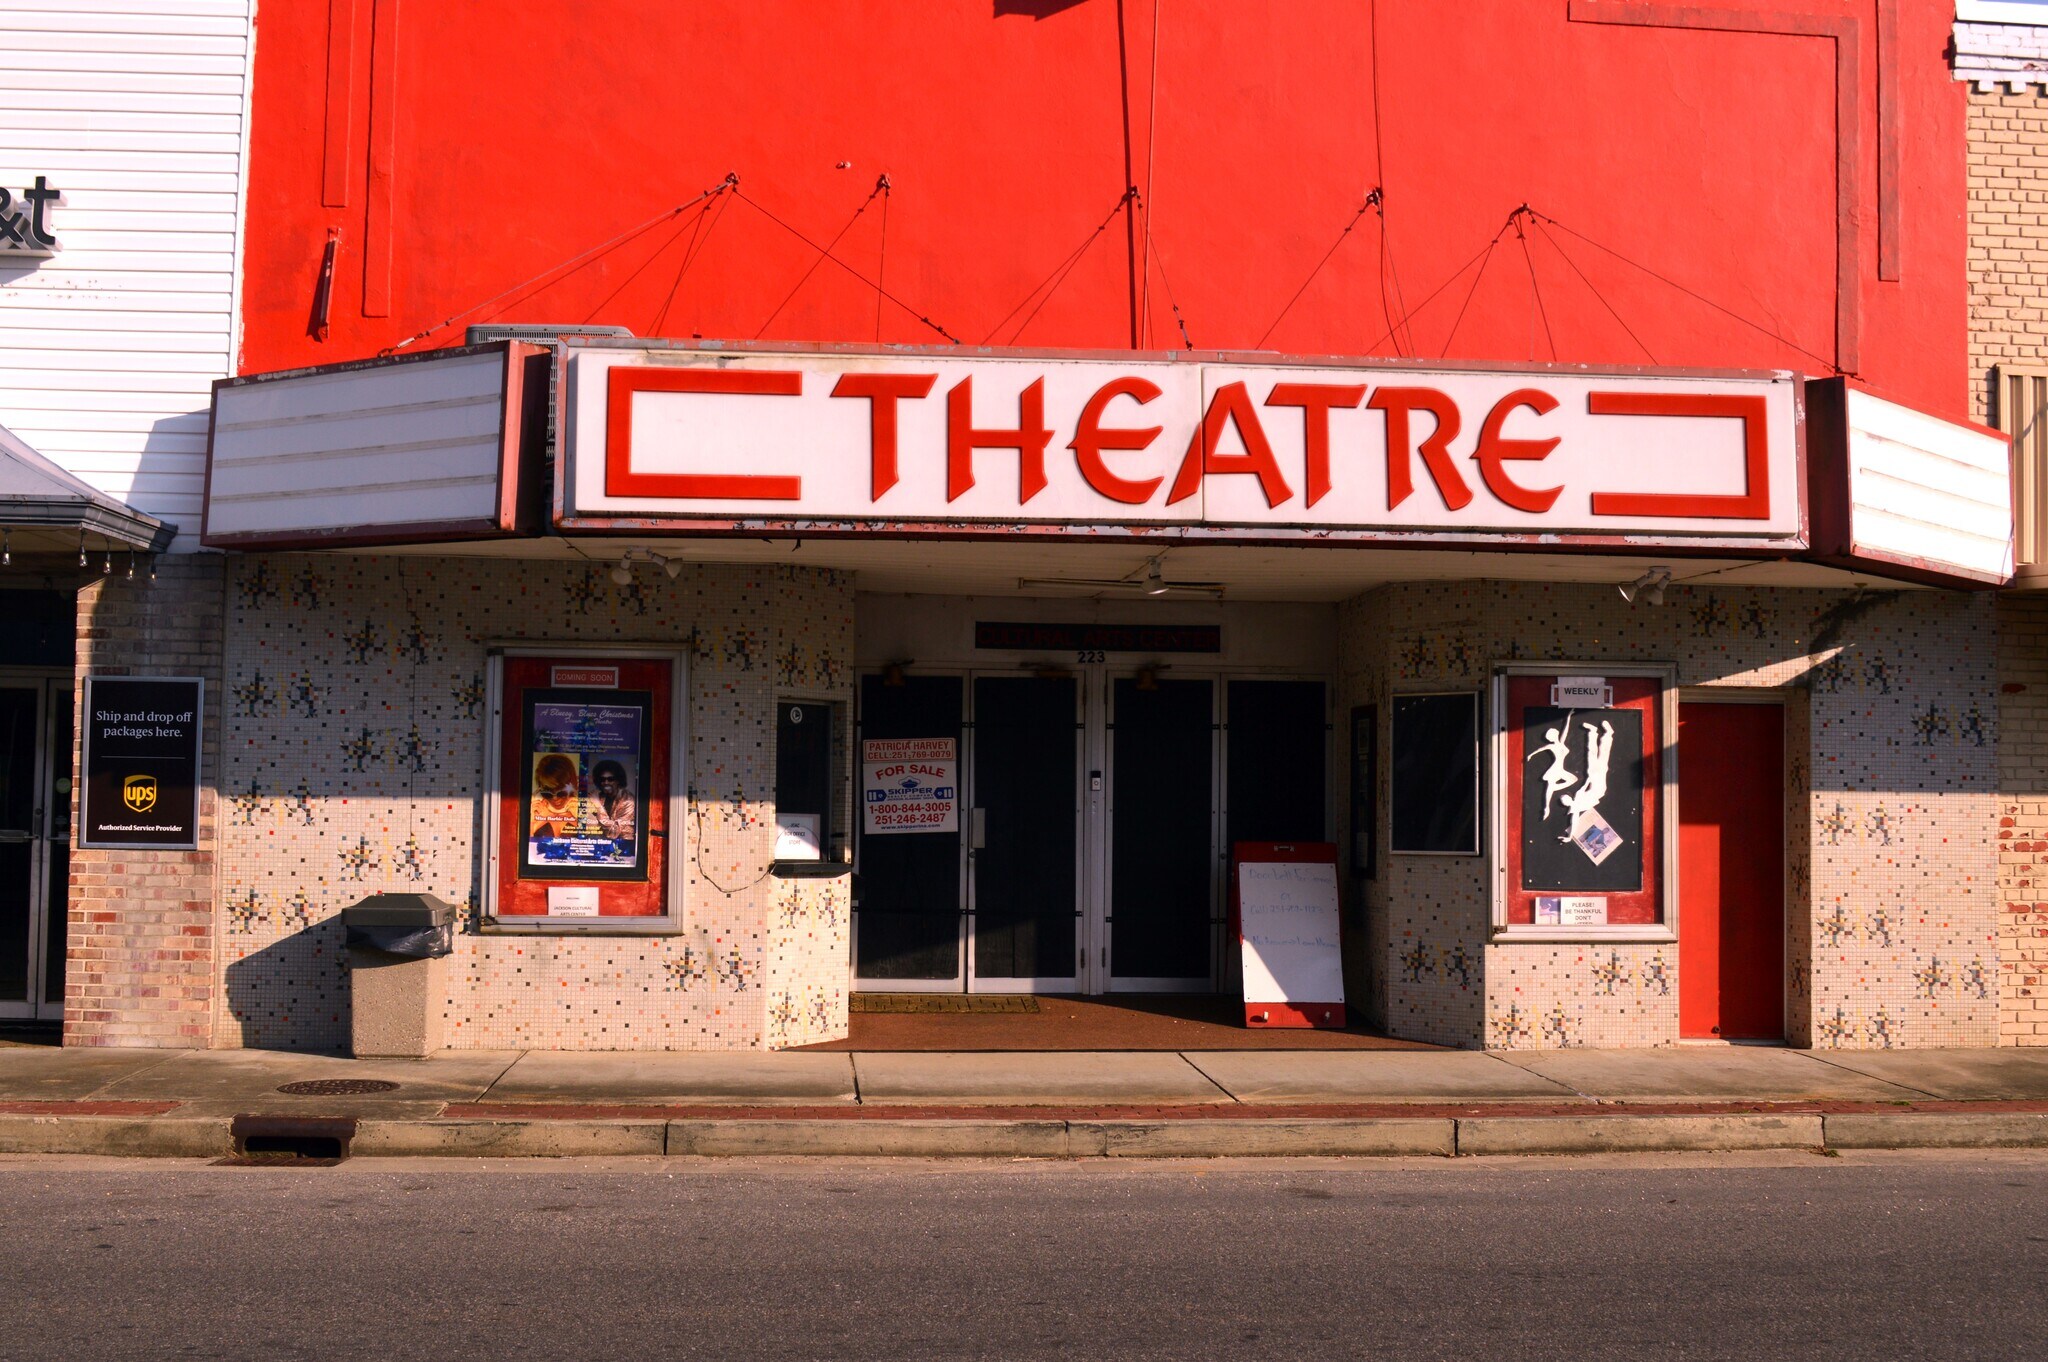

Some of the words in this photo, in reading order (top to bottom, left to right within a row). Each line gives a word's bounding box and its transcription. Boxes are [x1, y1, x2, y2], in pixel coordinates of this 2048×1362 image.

[830, 373, 1565, 514] THEATRE
[977, 626, 1075, 646] CULTURAL
[1083, 628, 1134, 648] ARTS
[1140, 630, 1219, 649] CENTER
[1077, 650, 1106, 663] 223
[556, 673, 586, 681] COMING
[590, 674, 613, 682] SOON
[1564, 687, 1599, 695] WEEKLY
[96, 711, 121, 723] Ship
[123, 711, 144, 721] and
[146, 711, 174, 724] drop
[176, 712, 193, 722] off
[599, 710, 634, 719] Christmas
[103, 726, 153, 739] packages
[155, 726, 183, 737] here.
[869, 742, 911, 751] PATRICIA
[913, 741, 949, 750] HARVEY
[875, 765, 905, 780] FOR
[909, 764, 946, 778] SALE
[127, 787, 154, 806] ups
[888, 787, 933, 795] SKIPPER
[869, 802, 951, 814] 1-800-844-3005
[875, 813, 946, 825] 251-246-2487
[98, 824, 132, 832] Authorized
[133, 824, 155, 832] Service
